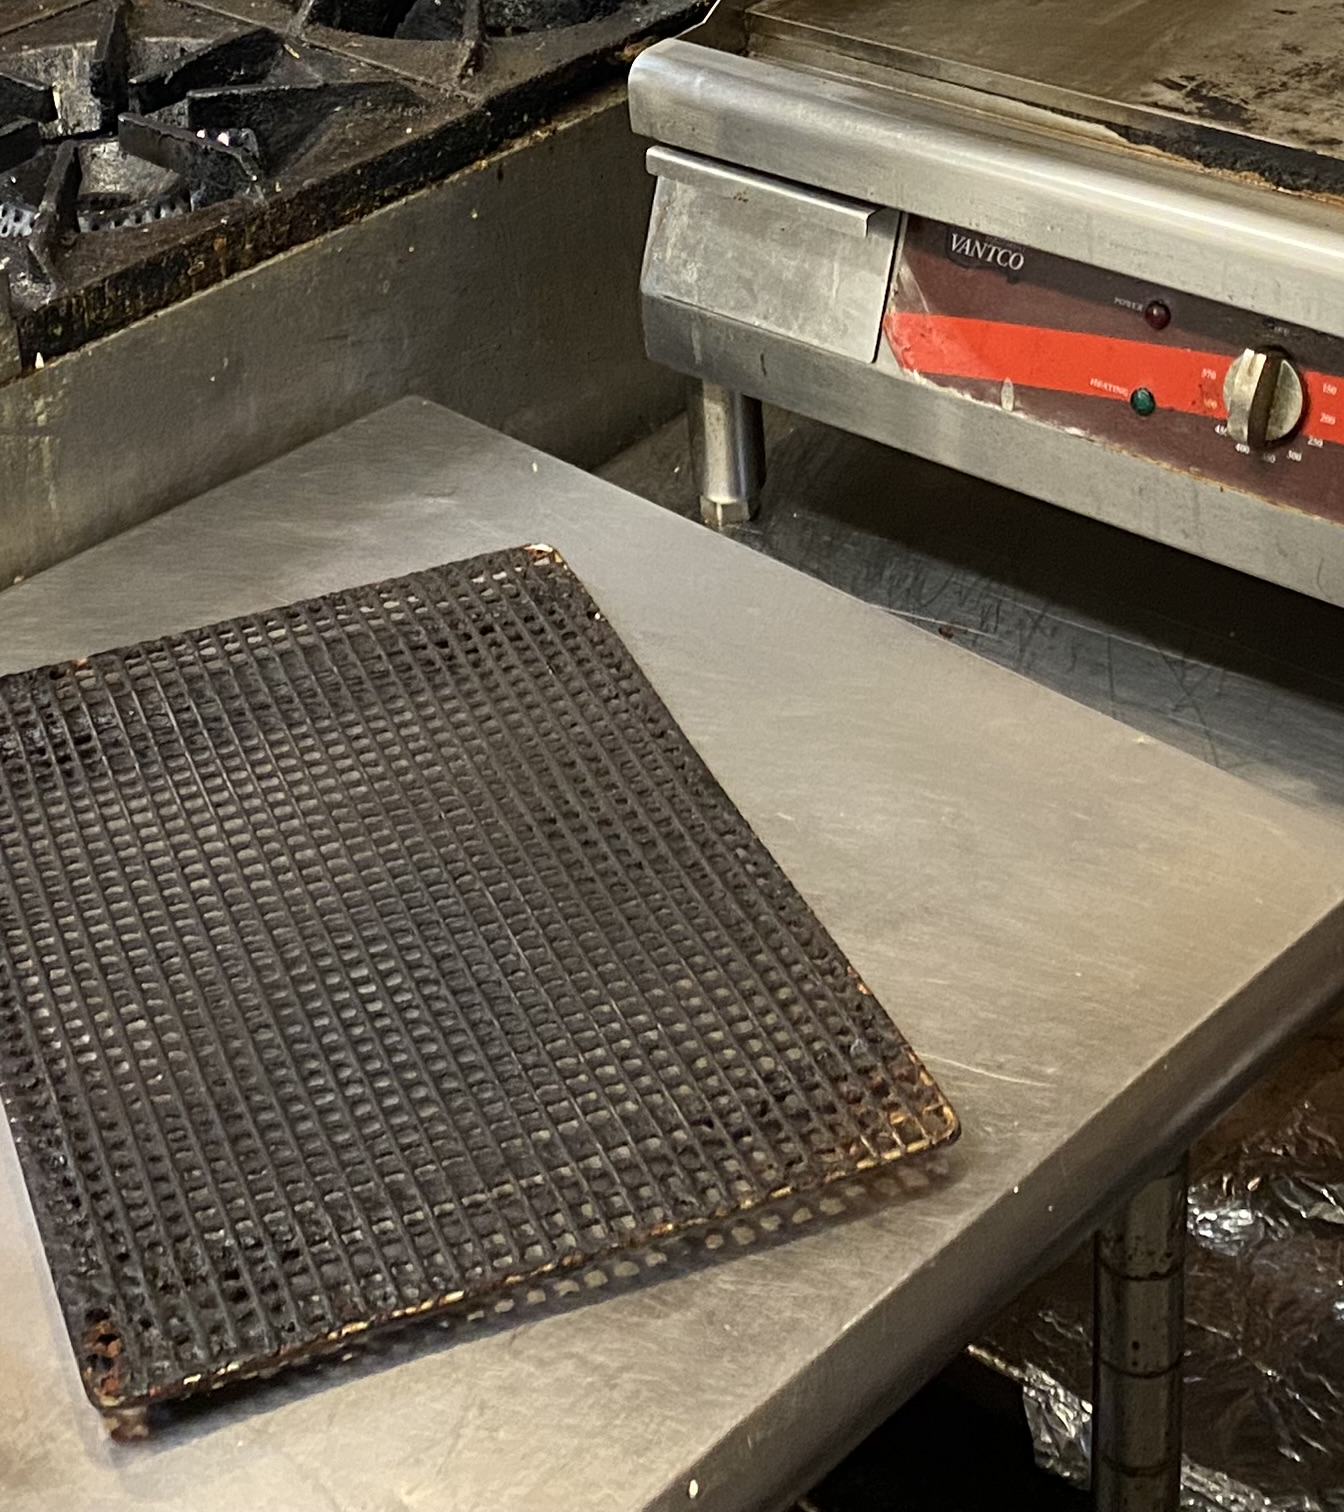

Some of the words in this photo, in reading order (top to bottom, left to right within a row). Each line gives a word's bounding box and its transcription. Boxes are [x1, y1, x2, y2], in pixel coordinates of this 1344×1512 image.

[949, 233, 1025, 271] VANTCO
[1090, 377, 1128, 397] HEATING
[1319, 412, 1336, 426] 200
[1307, 434, 1324, 448] 250
[1235, 443, 1250, 455] 400
[1286, 449, 1302, 462] 300
